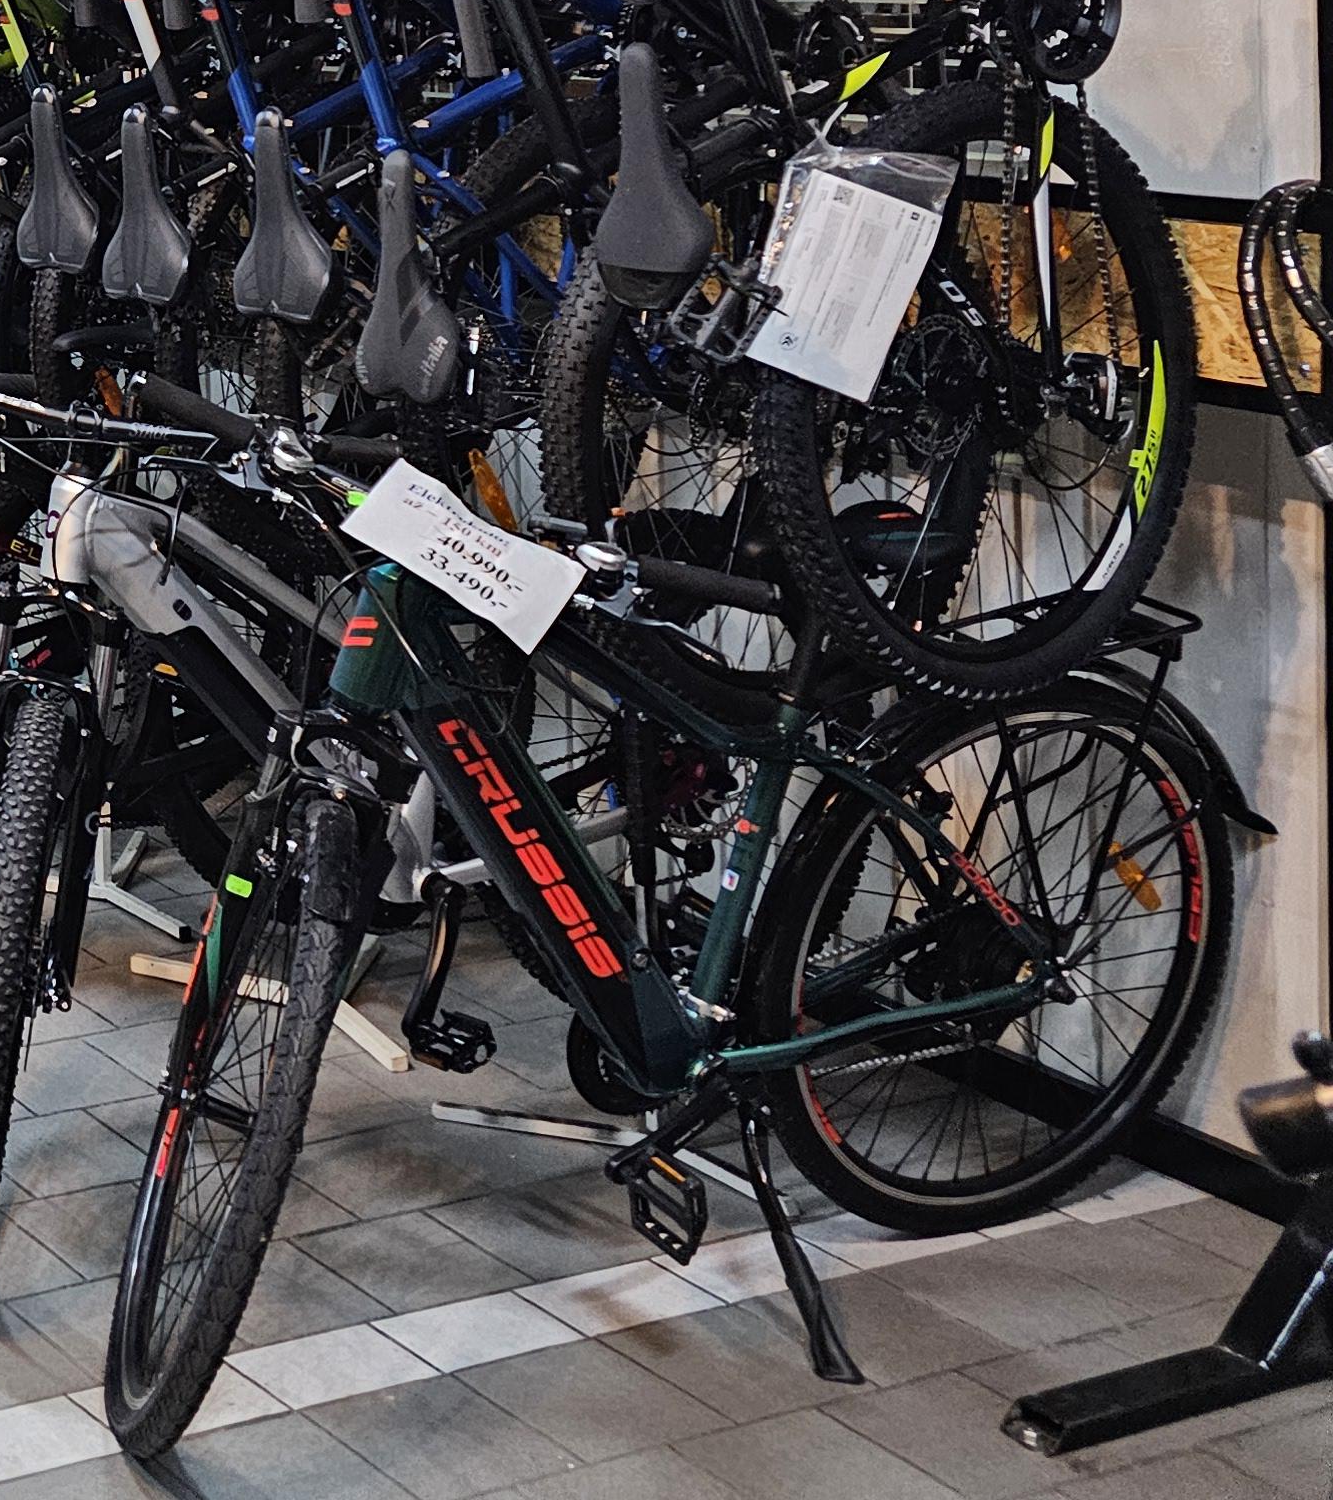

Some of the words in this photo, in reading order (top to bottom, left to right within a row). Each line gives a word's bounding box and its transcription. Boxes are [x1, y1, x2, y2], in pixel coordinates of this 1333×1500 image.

[419, 547, 509, 610] 33.490,-
[437, 534, 524, 593] 40.990,-
[436, 718, 624, 979] CRUSSIS
